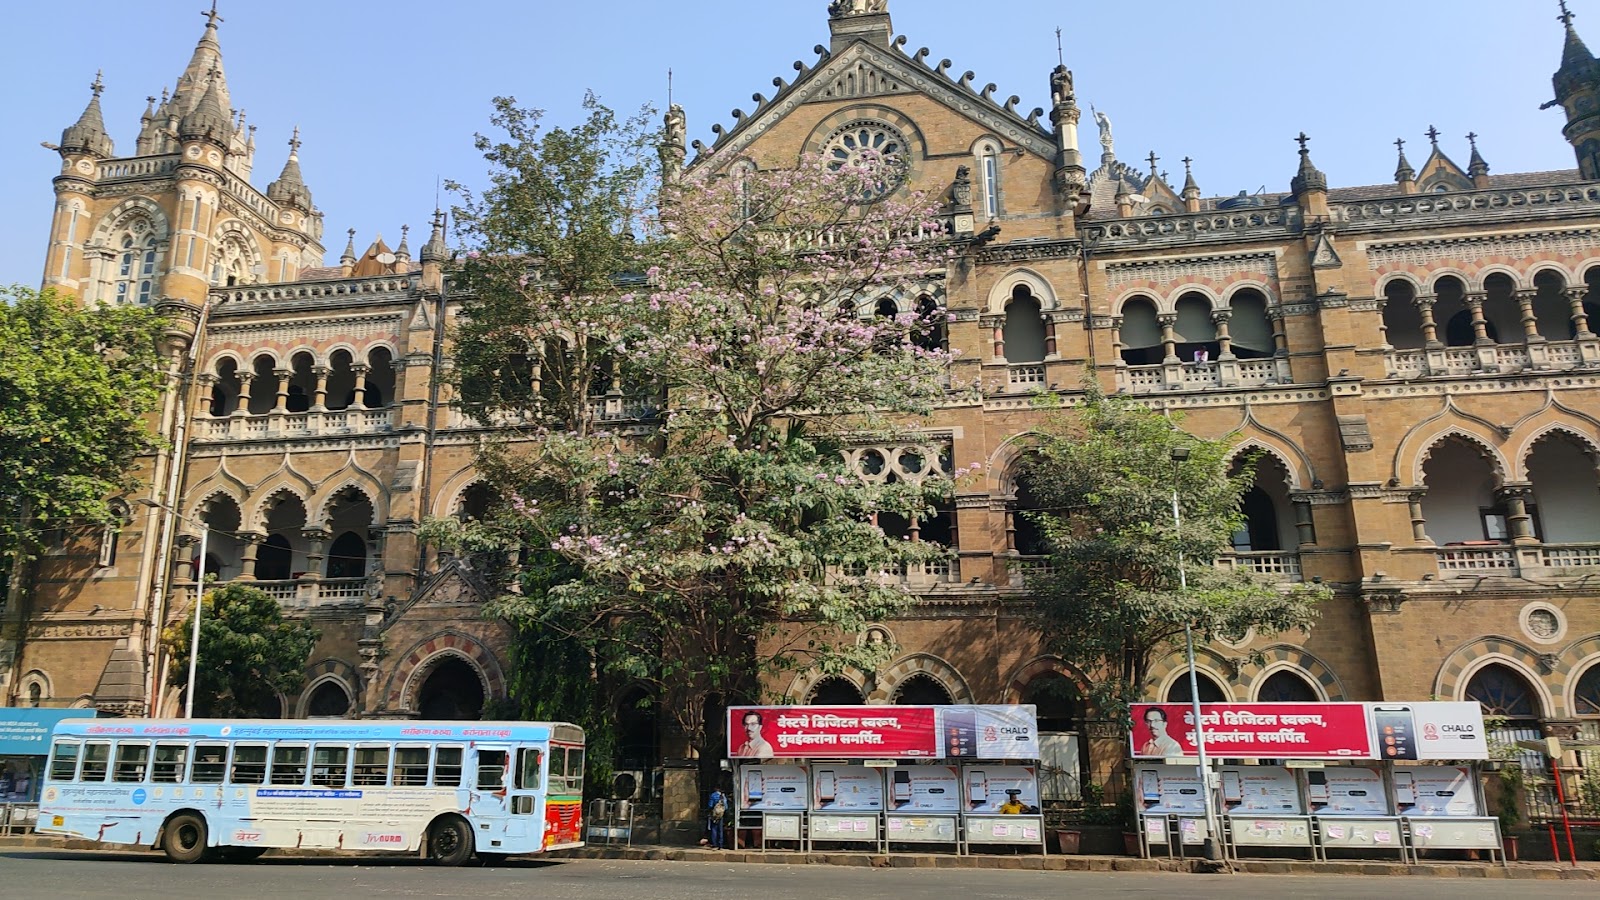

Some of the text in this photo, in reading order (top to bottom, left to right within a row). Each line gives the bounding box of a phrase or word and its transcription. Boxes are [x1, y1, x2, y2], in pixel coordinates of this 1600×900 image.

[812, 714, 858, 728] डिजिटल
[861, 717, 901, 729] स्वरूप,
[1222, 710, 1277, 726] डिजिटल
[1280, 714, 1327, 728] स्वरूप,
[1257, 728, 1309, 743] समर्पित.
[1441, 724, 1474, 732] CHALO
[777, 730, 884, 748] मुंबईकरांना समर्पित.
